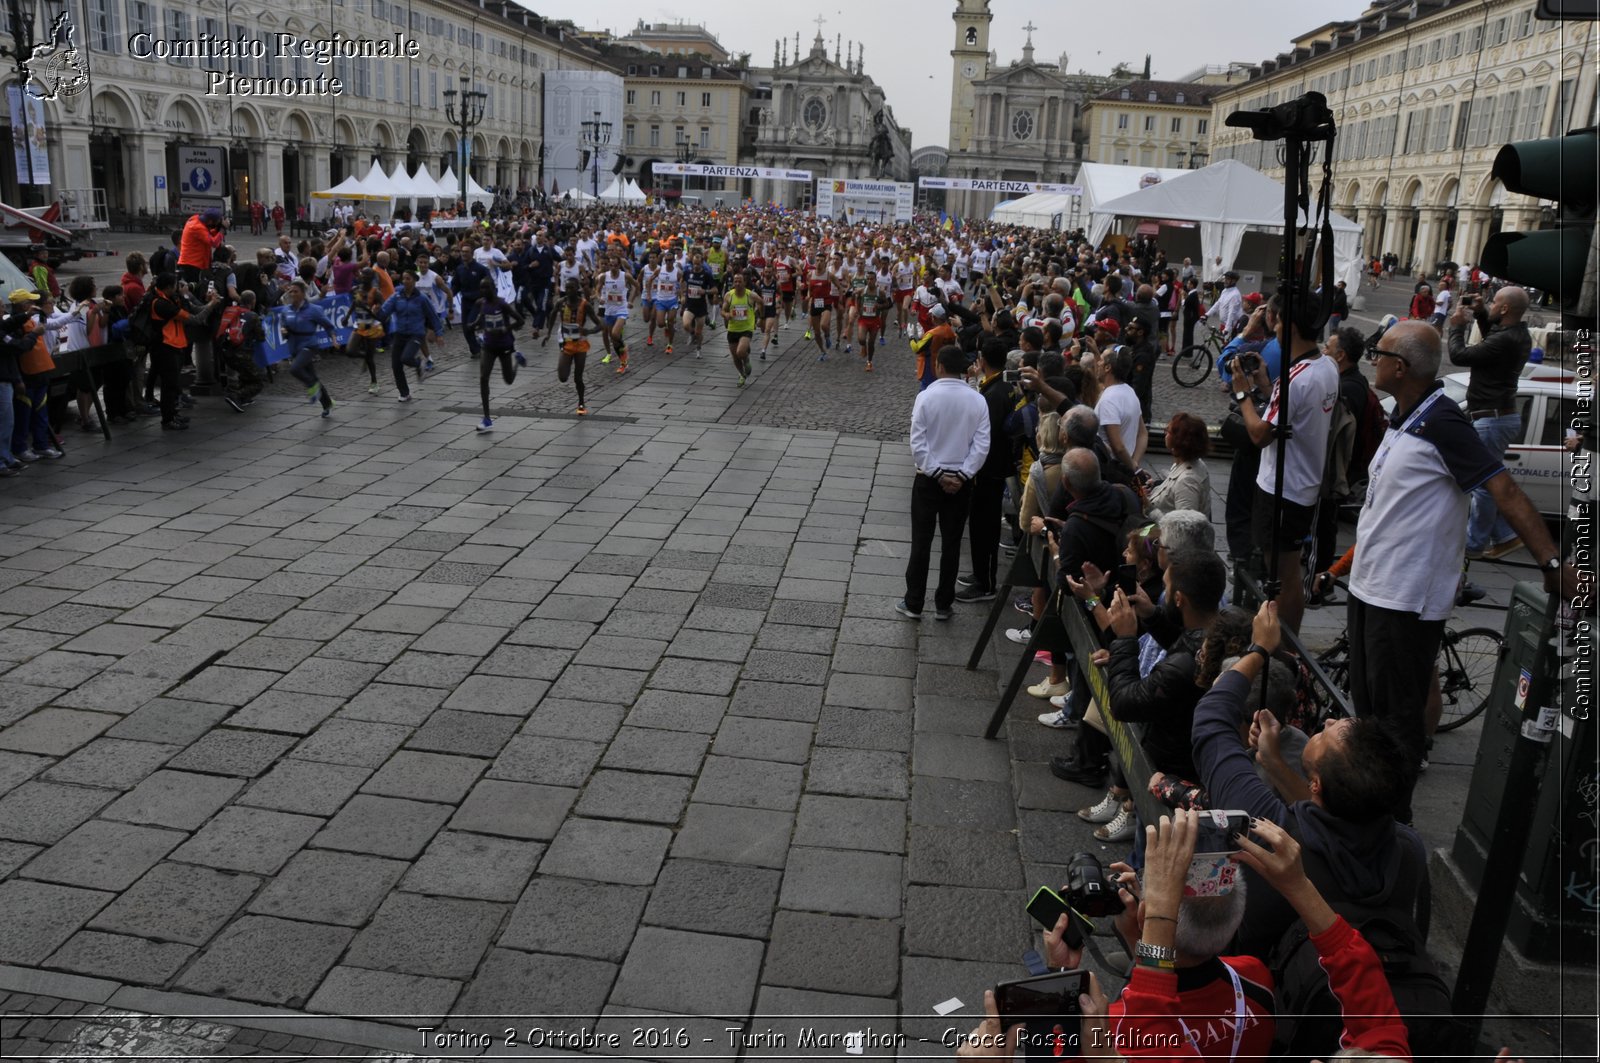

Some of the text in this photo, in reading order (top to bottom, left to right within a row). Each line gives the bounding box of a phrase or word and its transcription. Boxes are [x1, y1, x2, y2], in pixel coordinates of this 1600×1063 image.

[185, 157, 215, 165] pedonale
[703, 166, 759, 177] PARTENZA
[157, 176, 164, 187] P
[846, 182, 896, 192] TURIN MARATHON
[971, 180, 1030, 192] PARTENZA
